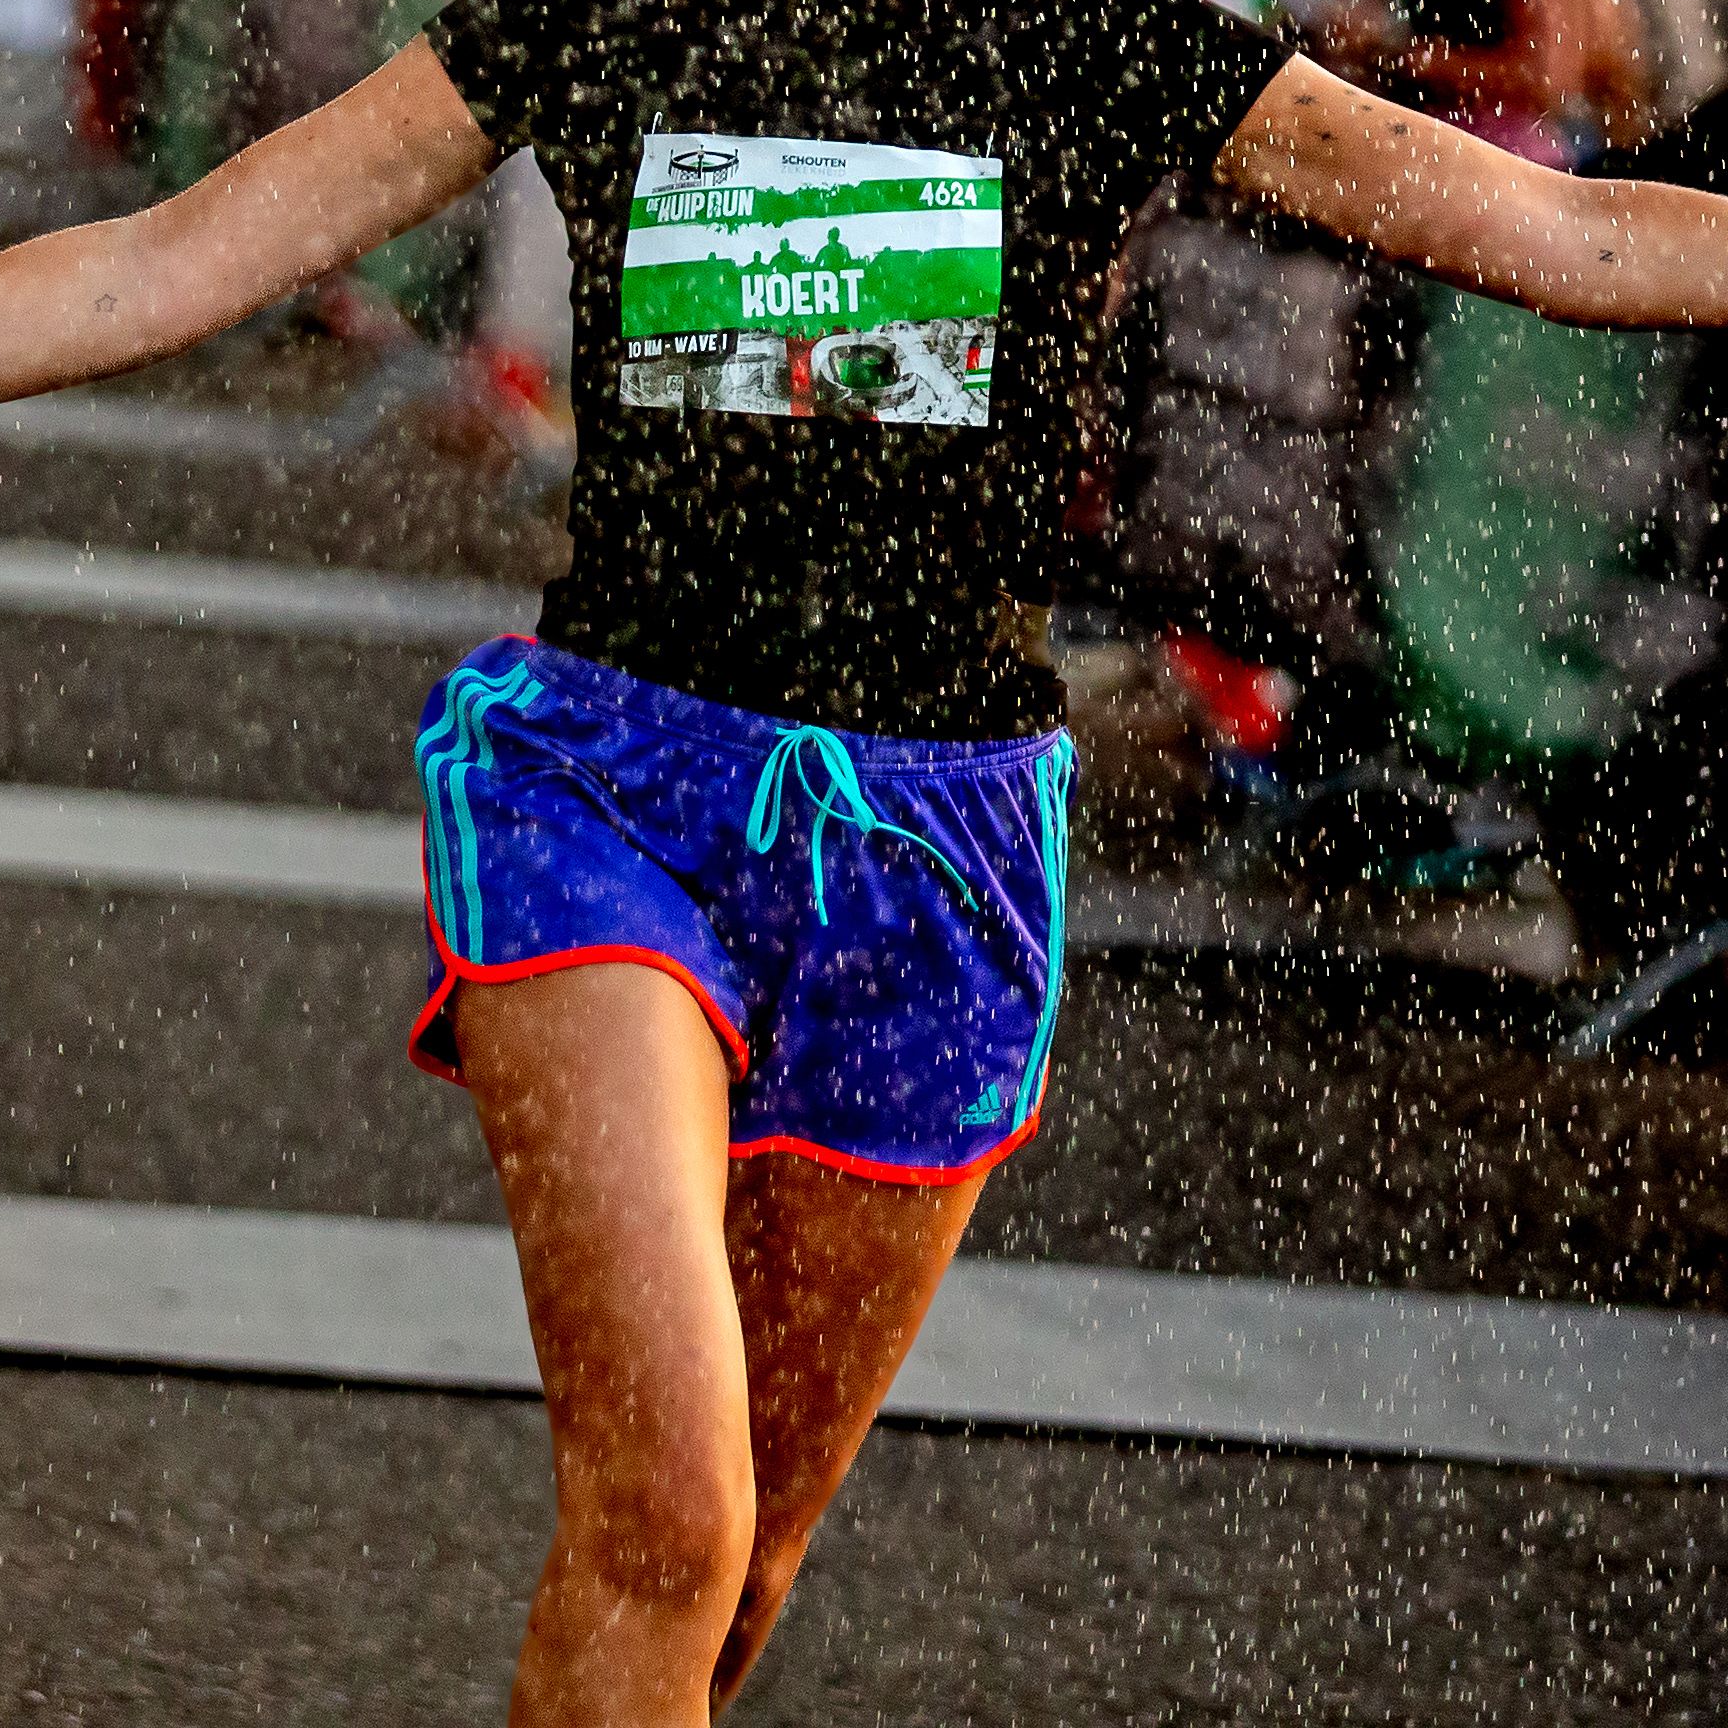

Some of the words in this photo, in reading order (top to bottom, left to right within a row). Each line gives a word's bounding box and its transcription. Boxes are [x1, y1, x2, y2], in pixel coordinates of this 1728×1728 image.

[781, 154, 847, 168] SCHOUTEN
[657, 191, 706, 223] KUIP
[706, 188, 755, 219] RUN
[918, 180, 978, 208] 4624
[740, 268, 865, 319] KOERT
[628, 341, 642, 359] 10
[674, 333, 718, 353] WAVE
